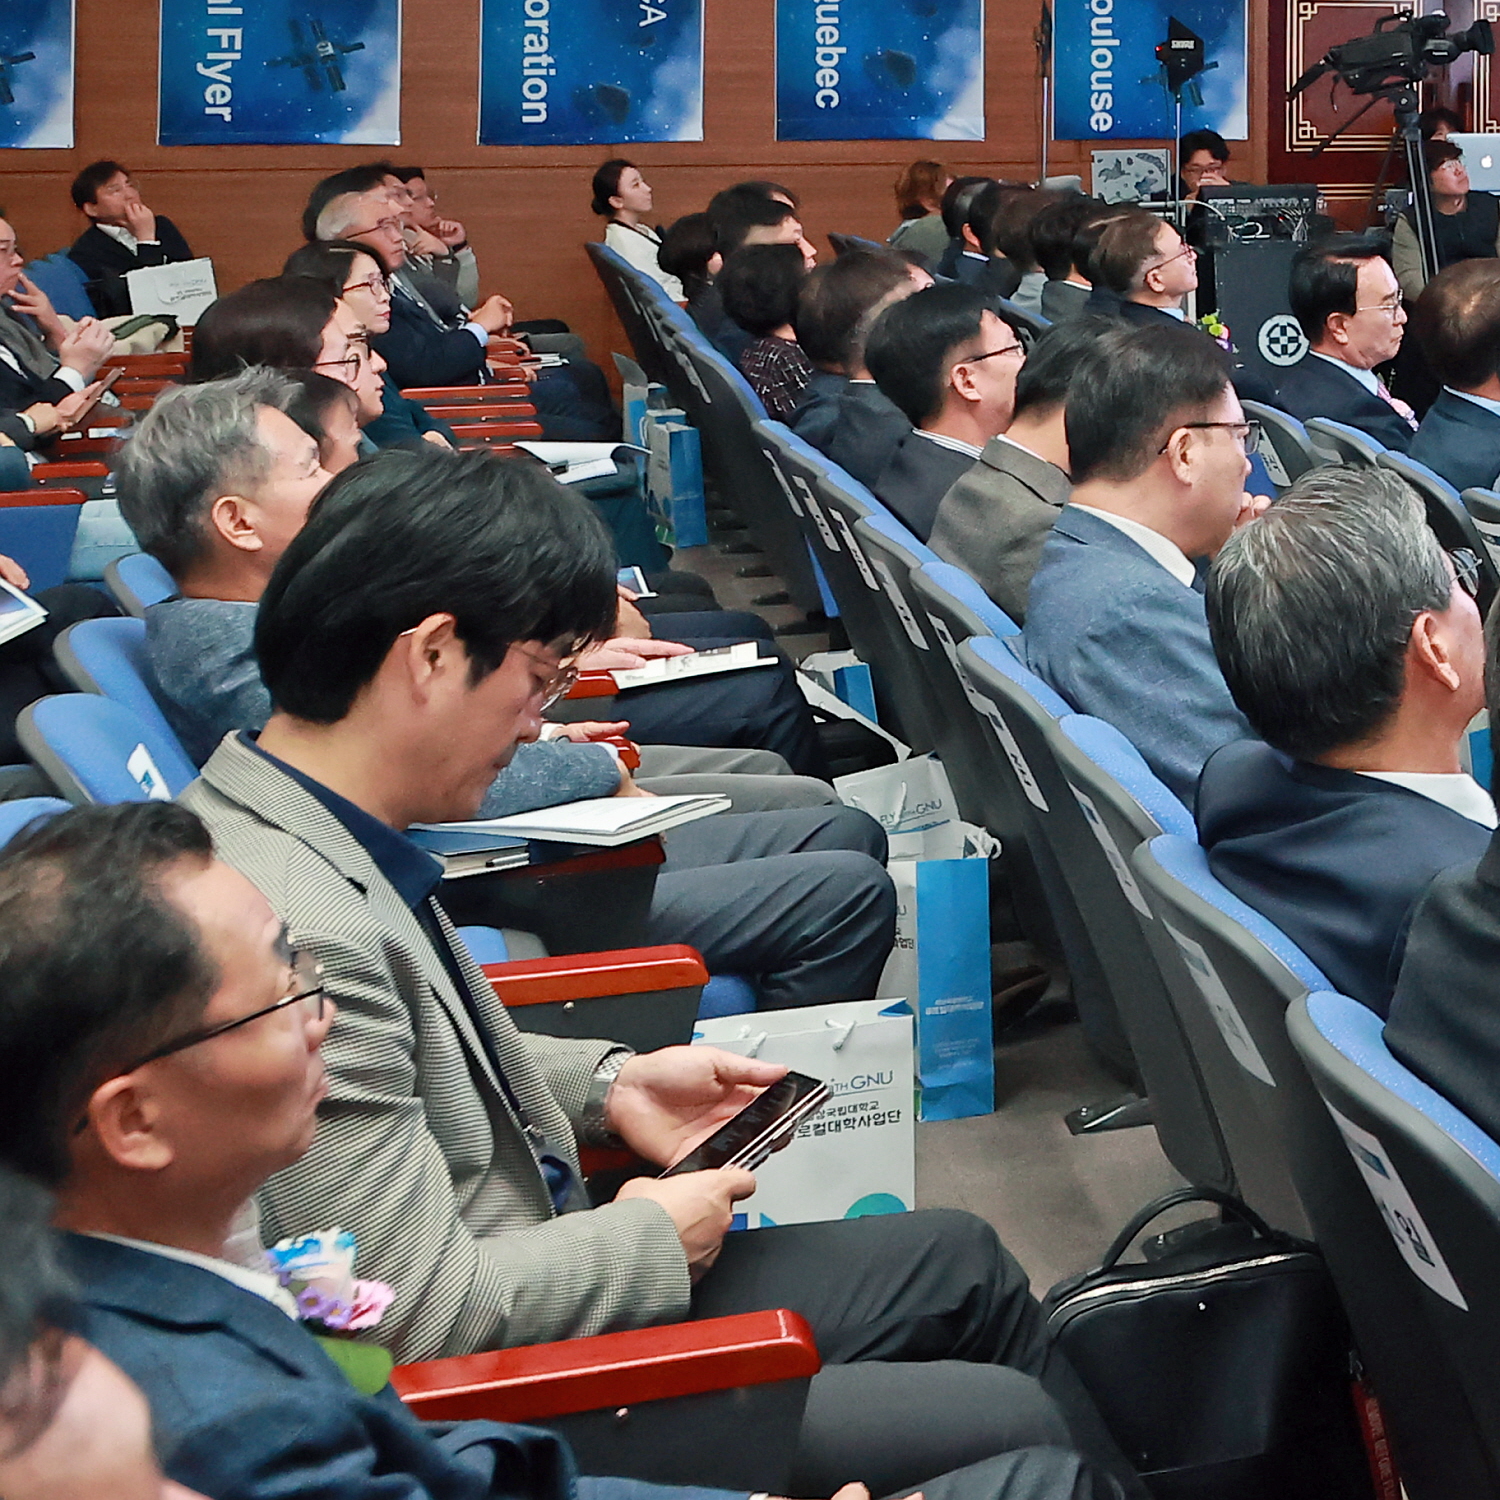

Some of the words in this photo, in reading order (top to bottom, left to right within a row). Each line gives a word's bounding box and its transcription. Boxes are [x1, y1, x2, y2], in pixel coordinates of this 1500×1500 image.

[196, 23, 242, 122] Flyer
[915, 799, 942, 815] GNU
[851, 1069, 893, 1090] GNU
[815, 1100, 880, 1120] 상국립대학교
[796, 1109, 902, 1139] 로컬대학사업단
